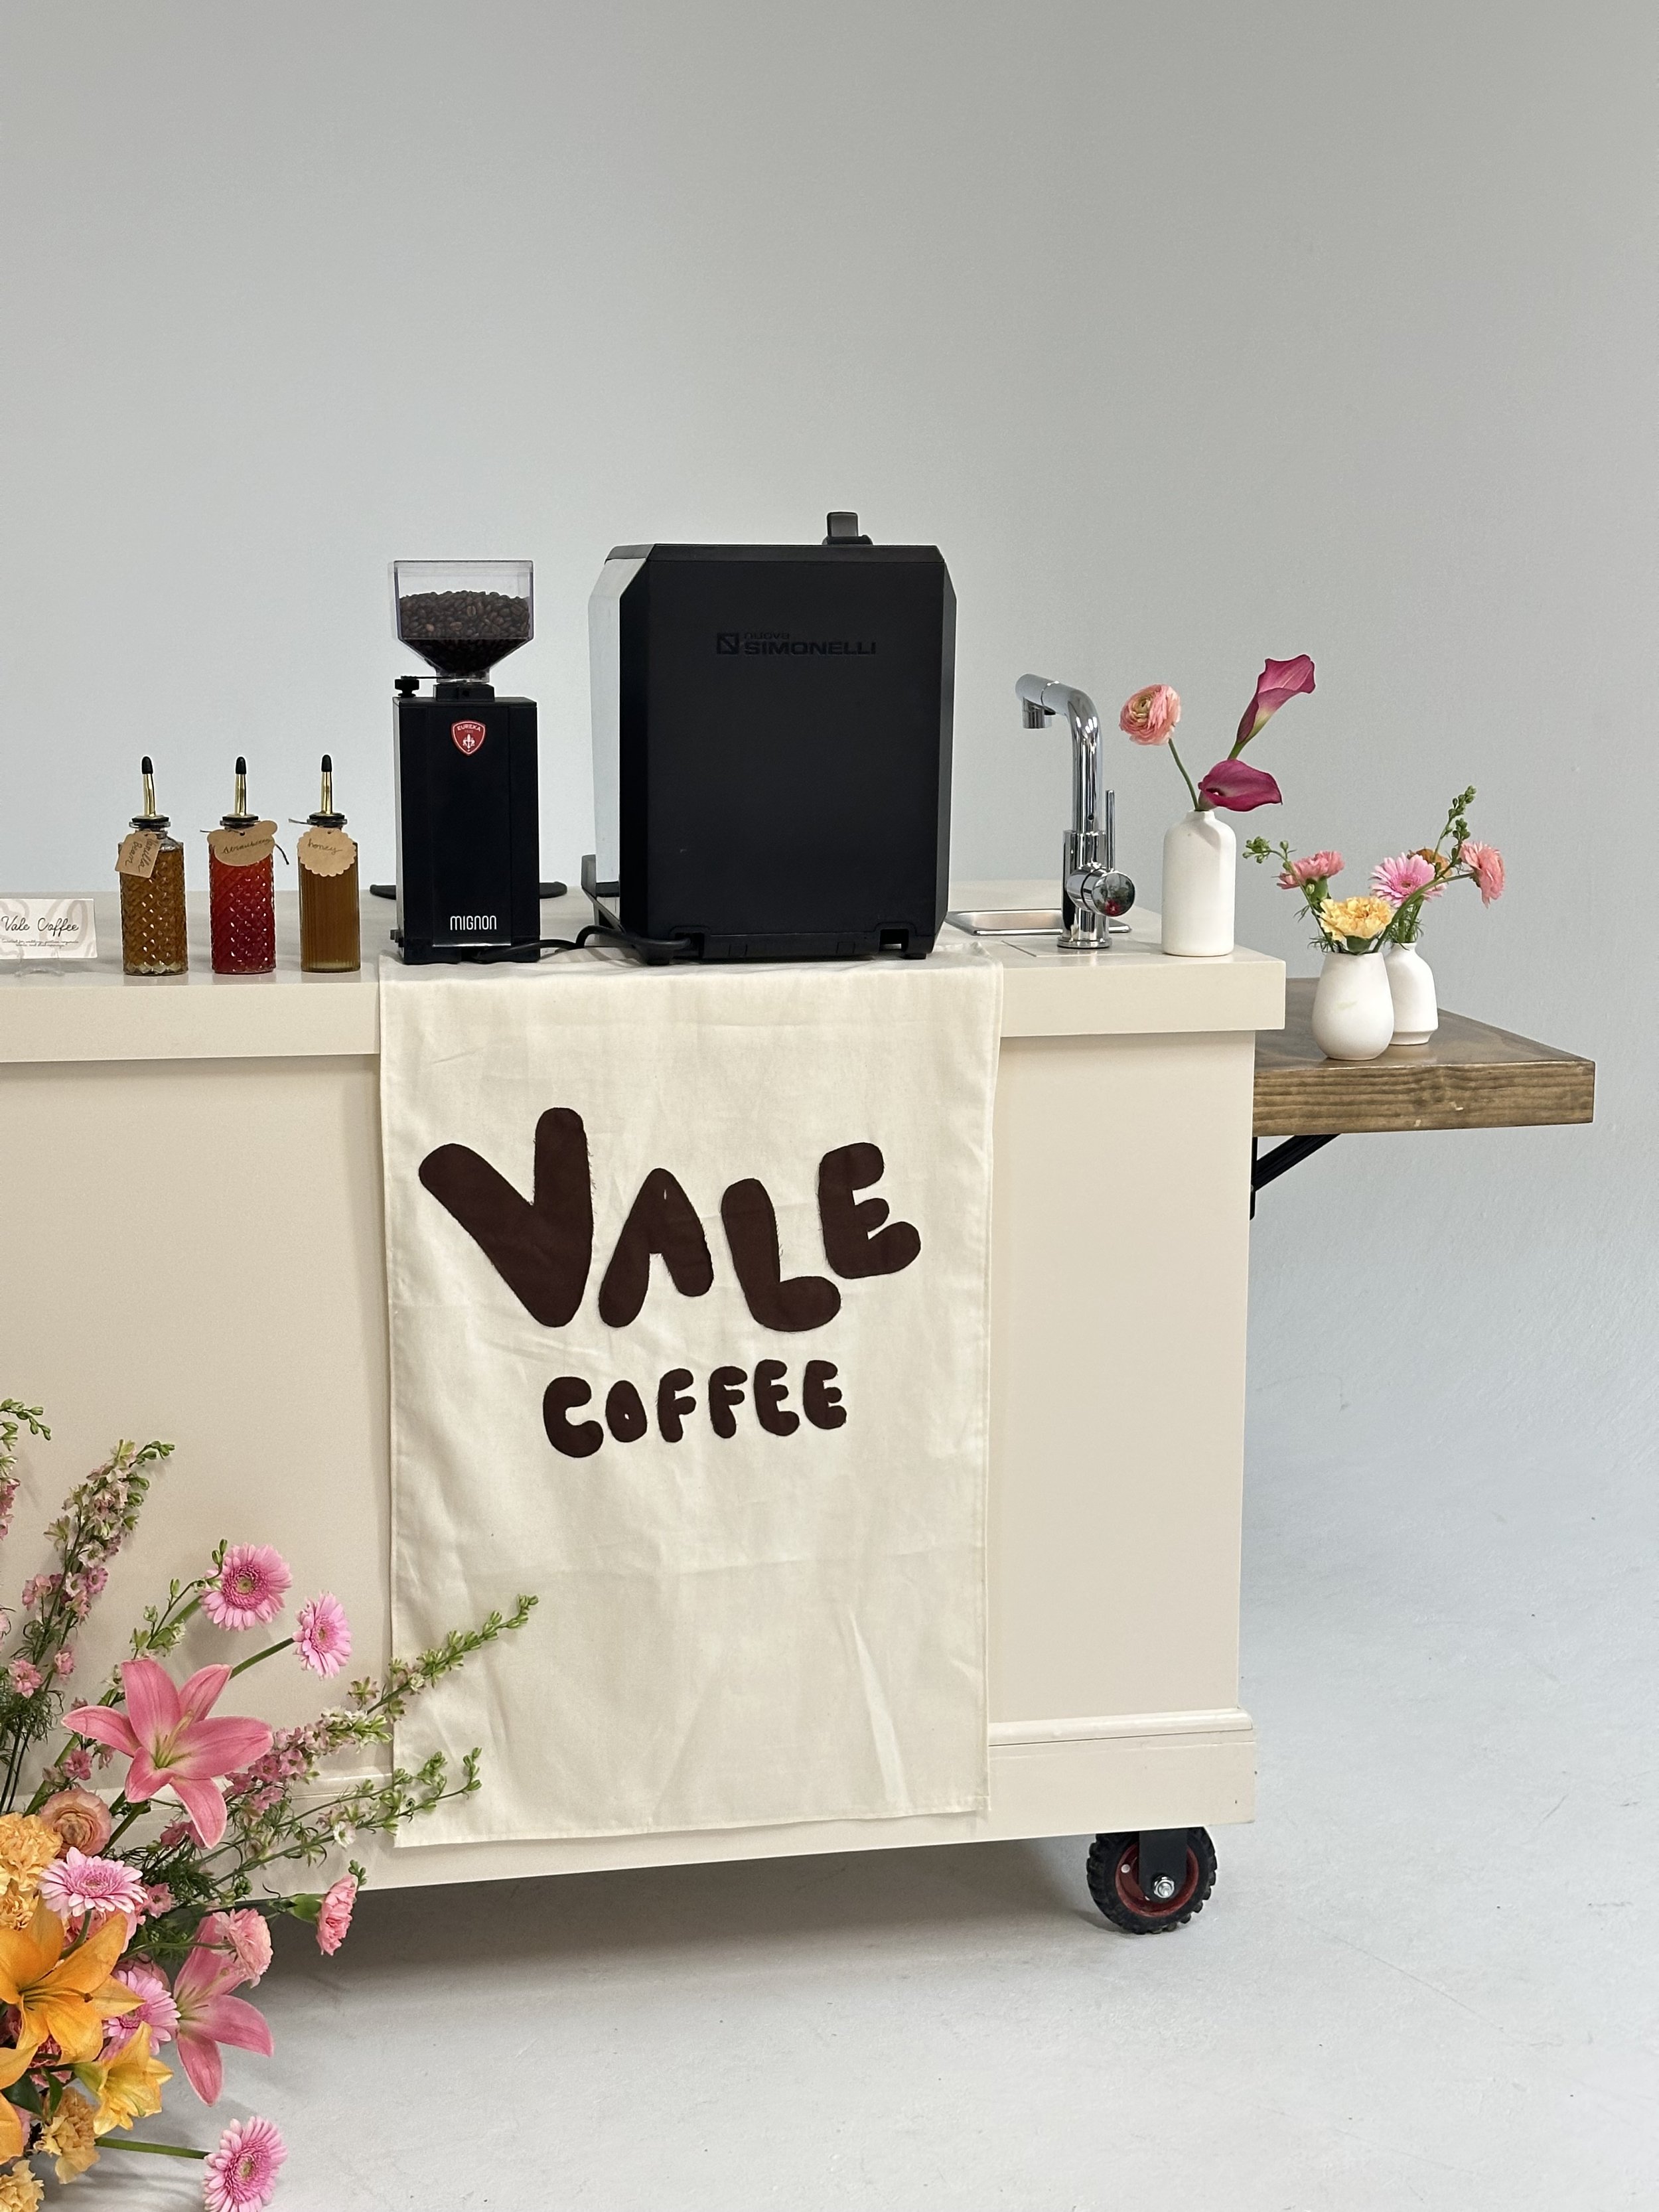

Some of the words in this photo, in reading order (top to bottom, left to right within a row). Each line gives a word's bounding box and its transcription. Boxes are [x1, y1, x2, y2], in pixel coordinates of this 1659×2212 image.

[744, 641, 877, 655] SIMONELLI
[125, 841, 143, 866] Bean
[137, 839, 159, 873] Vanilla
[308, 838, 342, 855] honey
[1, 915, 31, 931] Vale
[37, 917, 79, 937] Coffee
[450, 915, 497, 930] MIGNON
[419, 1106, 922, 1332] VALE
[543, 1359, 847, 1458] COFFEE
